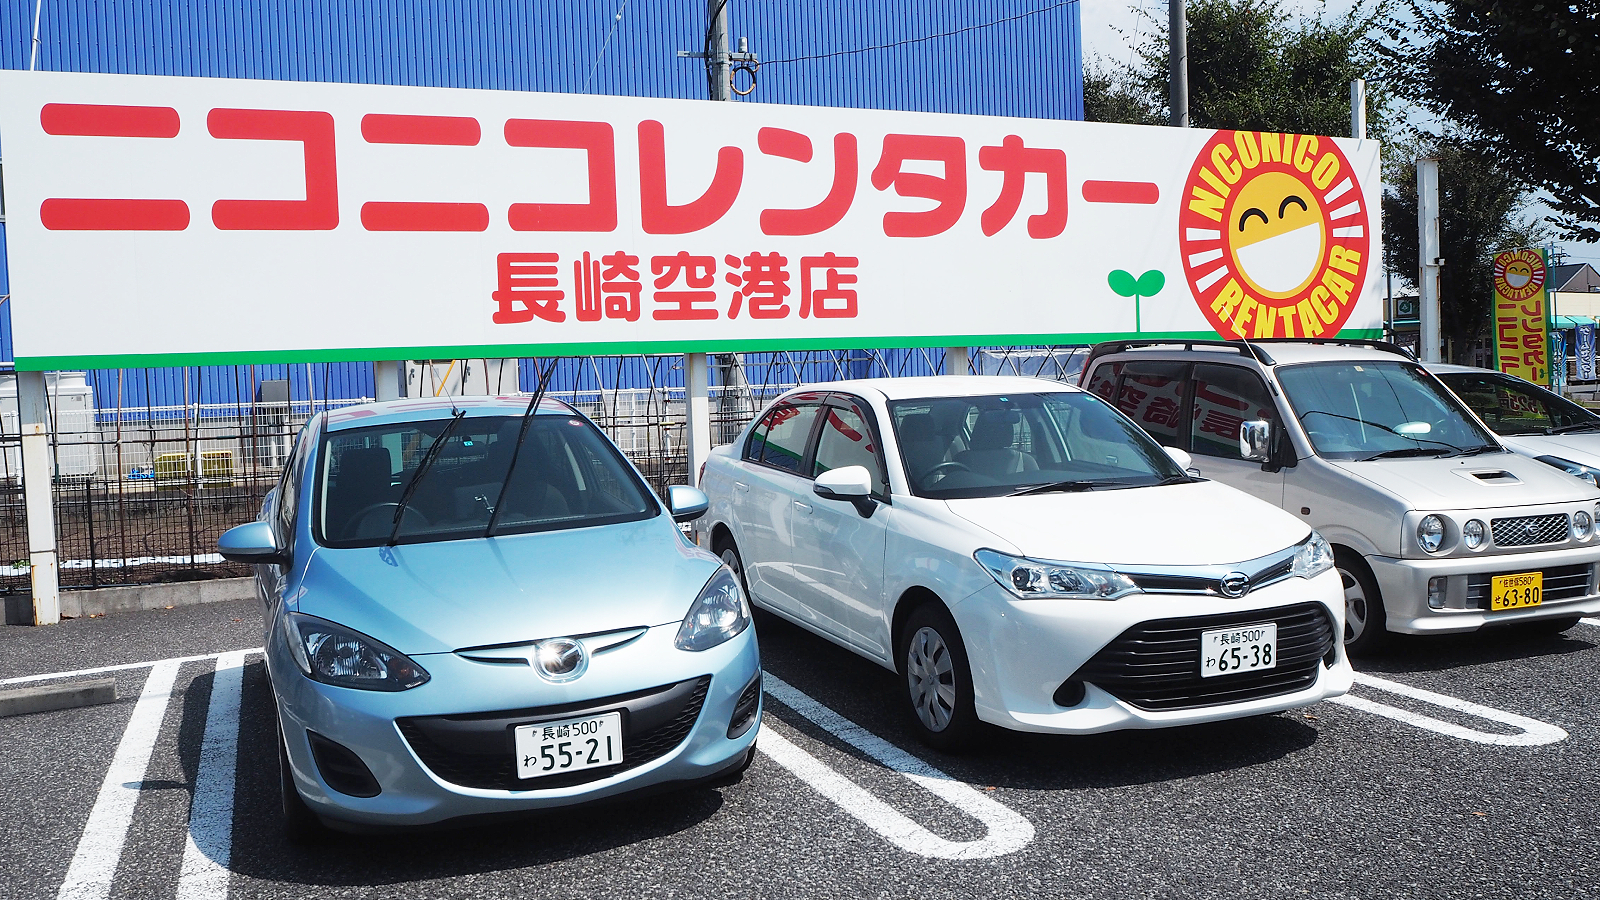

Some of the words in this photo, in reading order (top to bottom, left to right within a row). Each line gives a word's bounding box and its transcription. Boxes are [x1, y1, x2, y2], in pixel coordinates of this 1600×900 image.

[40, 102, 1159, 238] ニコニコレンタカー
[1188, 130, 1340, 222] NICONICO
[492, 252, 860, 325] 長崎空港店
[1210, 244, 1361, 339] RENTACAR
[1503, 587, 1539, 606] 63-80
[1206, 656, 1215, 668] わ
[1219, 643, 1272, 672] 65-38
[524, 754, 537, 767] わ
[541, 735, 612, 771] 55-21
